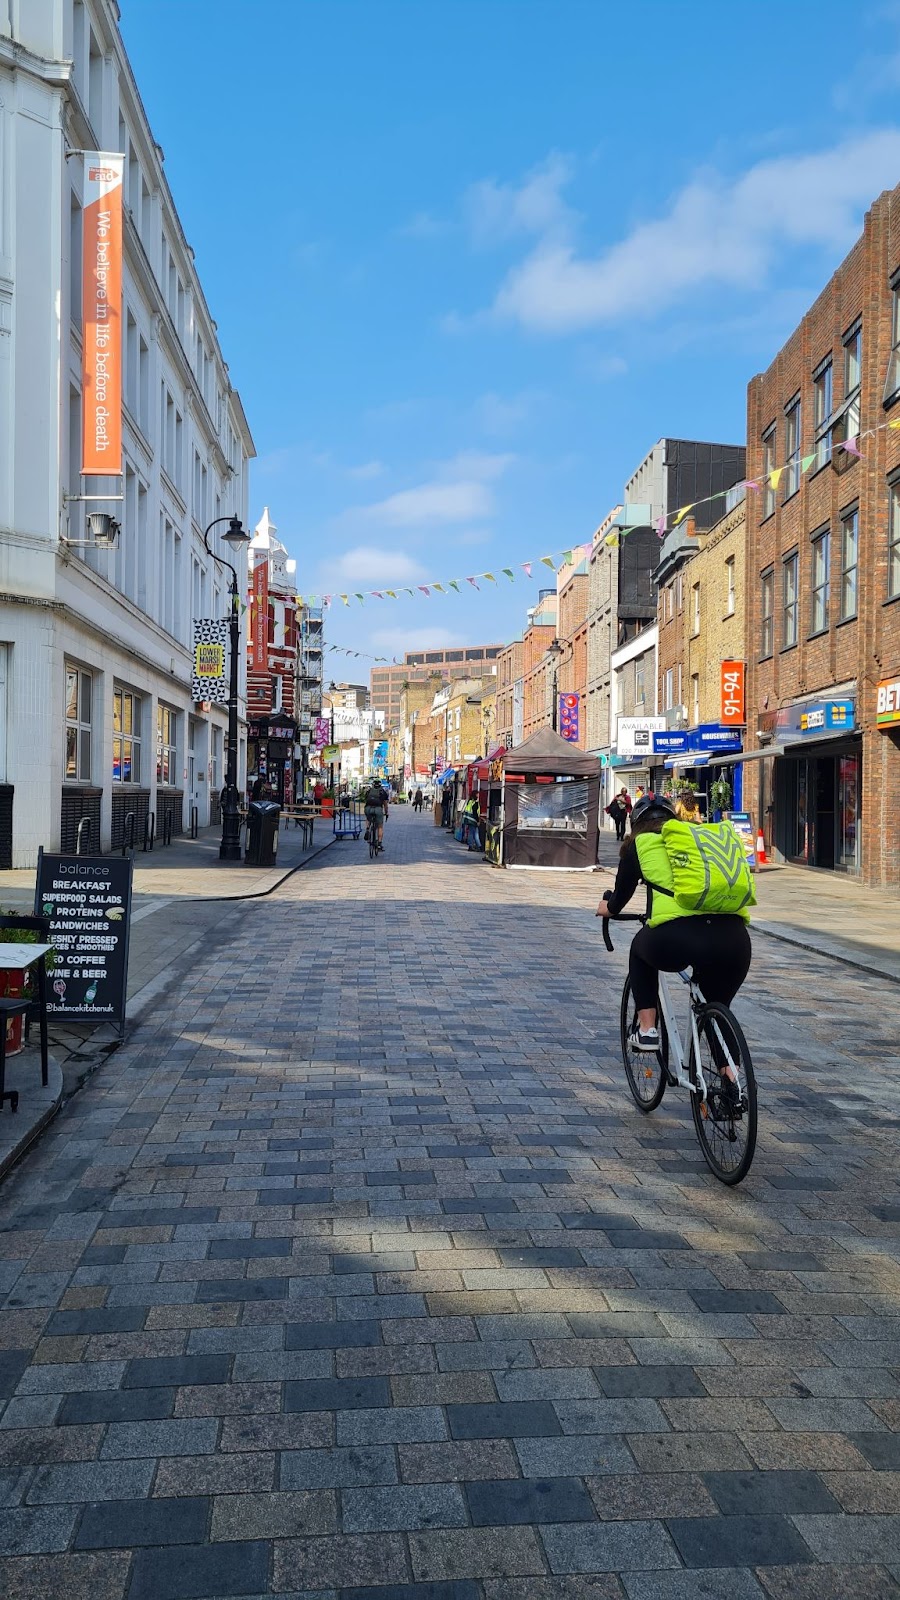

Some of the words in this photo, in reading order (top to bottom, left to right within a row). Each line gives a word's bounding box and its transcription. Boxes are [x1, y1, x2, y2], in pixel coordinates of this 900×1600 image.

[95, 169, 113, 182] aid
[96, 211, 111, 237] We
[96, 242, 110, 299] believe
[96, 303, 108, 319] in
[95, 324, 110, 348] life
[95, 352, 110, 402] before
[95, 406, 110, 452] death
[199, 647, 220, 656] LOWER
[199, 655, 220, 664] MARSH
[199, 663, 219, 673] MARKET
[724, 671, 740, 716] 91-94
[702, 732, 739, 740] HOUSEWARES
[59, 863, 110, 876] balance
[52, 880, 111, 891] BREAKFAST
[42, 893, 86, 903] SUPERFOOD
[89, 894, 122, 904] SALADS
[56, 907, 103, 917] PROTEINS
[49, 920, 109, 931] SANDWICHES
[79, 935, 118, 944] PRESSED
[67, 955, 106, 965] COFFEE
[46, 968, 70, 978] WINE
[73, 969, 80, 978] &
[82, 969, 107, 979] BEER
[45, 1002, 114, 1013] @balancekitchenuk
